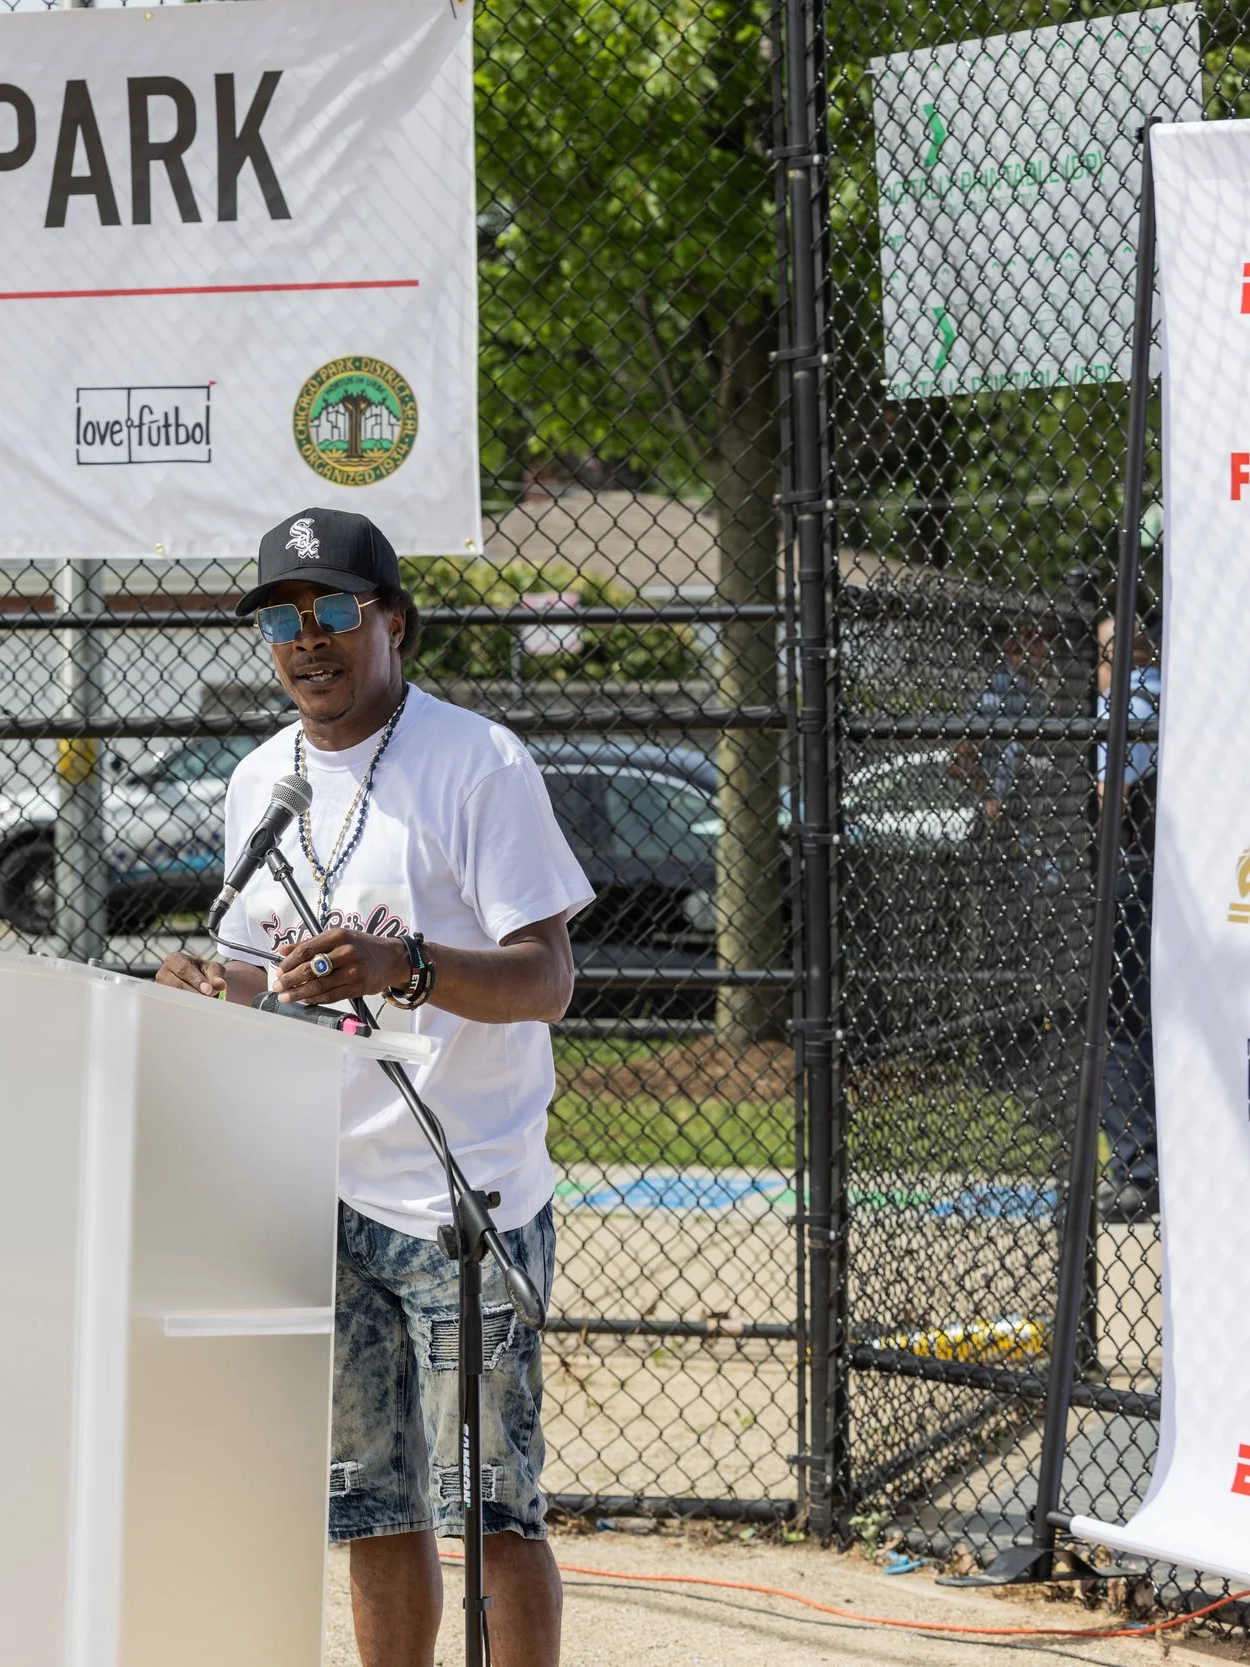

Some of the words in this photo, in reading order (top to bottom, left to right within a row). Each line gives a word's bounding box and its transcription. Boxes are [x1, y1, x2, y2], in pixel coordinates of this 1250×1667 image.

[294, 380, 321, 440] CHICAGO
[319, 358, 355, 381] PARK
[361, 358, 410, 397] DISTRICT
[403, 402, 417, 436] SEAL
[76, 406, 123, 447] love
[301, 443, 376, 485] ORGANIZED
[380, 443, 411, 476] 1934
